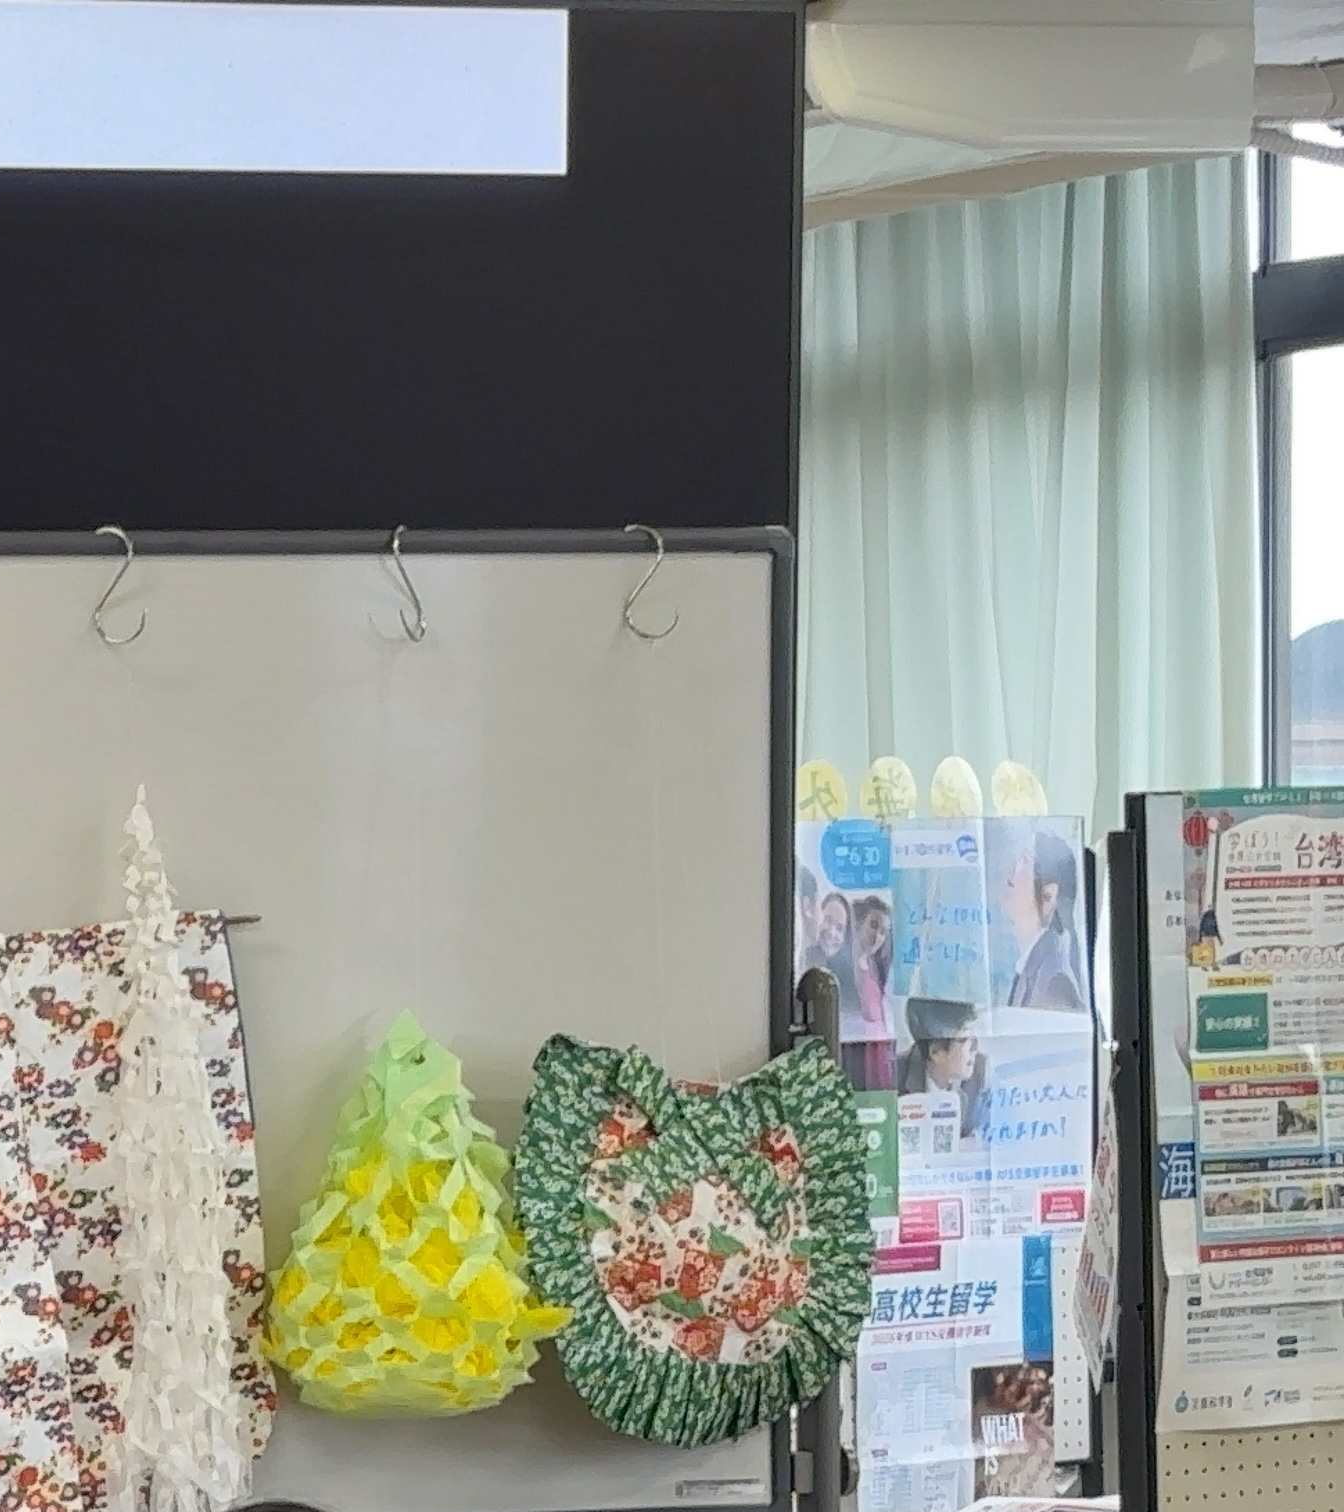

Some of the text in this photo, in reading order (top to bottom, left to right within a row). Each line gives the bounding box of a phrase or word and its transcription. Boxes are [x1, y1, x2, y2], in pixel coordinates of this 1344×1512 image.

[1159, 1145, 1195, 1197] 海
[870, 1279, 998, 1325] 高校生留学
[980, 1412, 1025, 1444] WHAT
